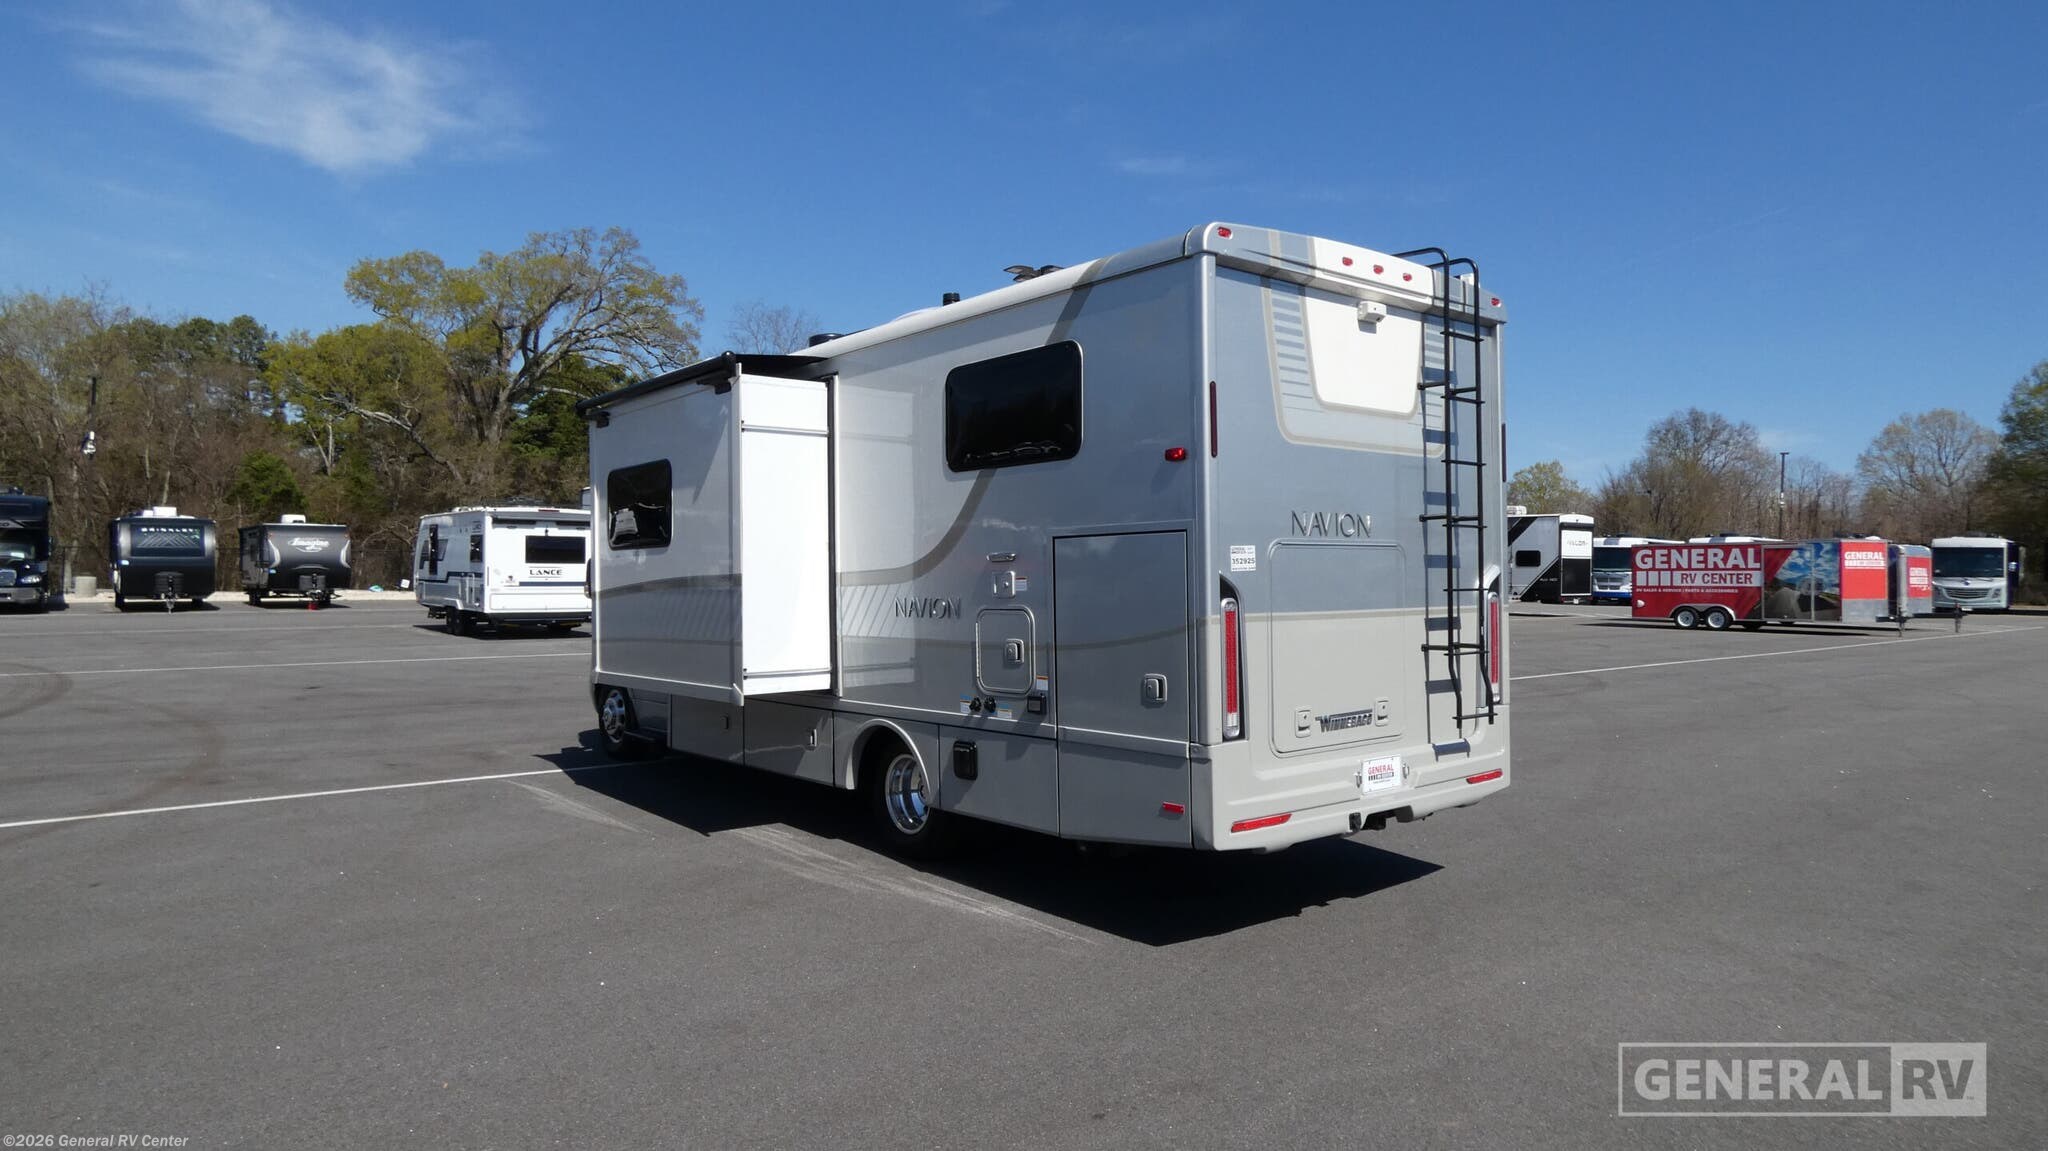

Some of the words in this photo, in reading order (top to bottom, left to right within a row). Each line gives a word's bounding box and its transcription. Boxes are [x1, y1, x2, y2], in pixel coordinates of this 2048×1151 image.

[1291, 511, 1372, 538] NAVION
[1635, 548, 1761, 569] GENERAL
[1844, 551, 1884, 560] GENERAL
[1680, 573, 1697, 585] RV
[1702, 573, 1753, 585] CENTER
[895, 597, 961, 619] NAVION
[1368, 764, 1395, 775] GENERAL
